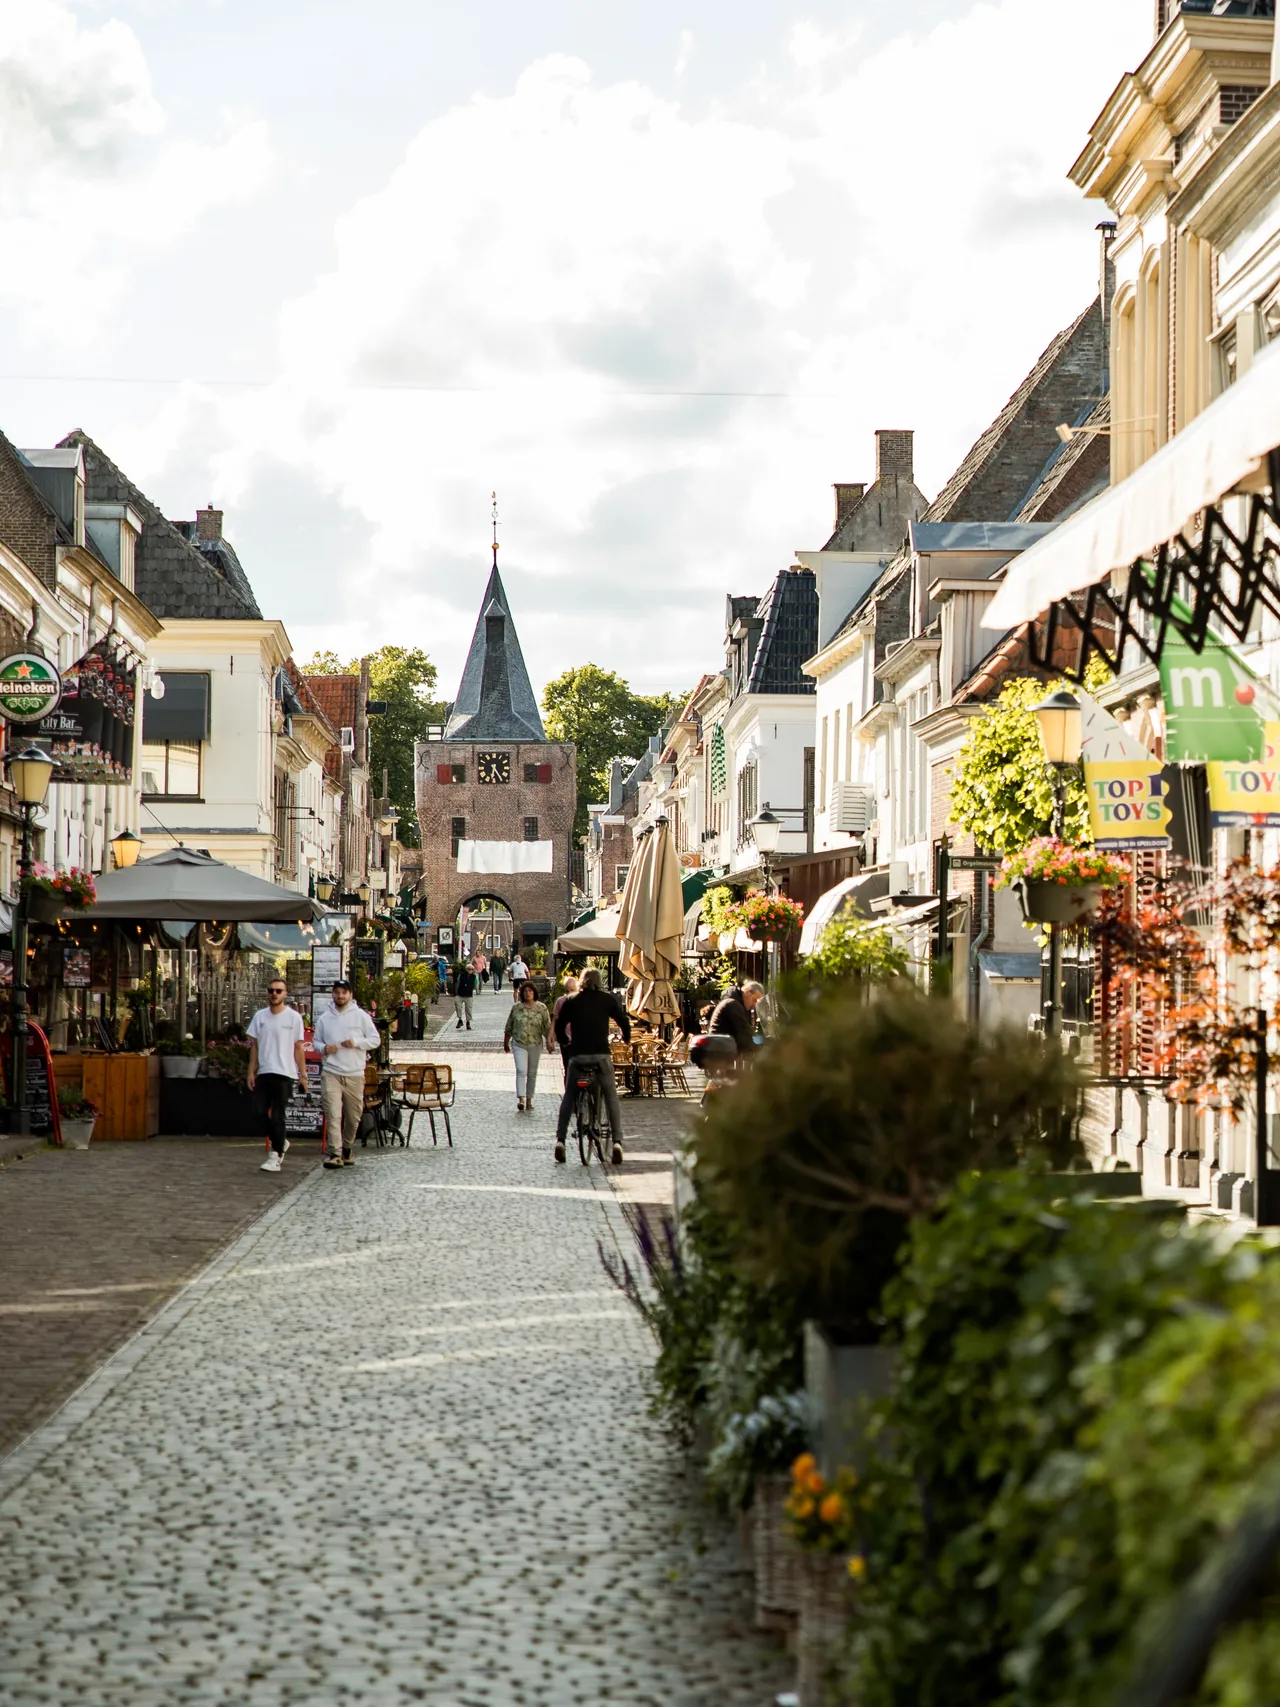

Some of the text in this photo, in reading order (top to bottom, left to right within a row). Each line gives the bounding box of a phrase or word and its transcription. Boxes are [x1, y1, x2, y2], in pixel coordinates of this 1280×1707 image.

[1168, 666, 1225, 708] m
[60, 716, 76, 729] Bar
[1099, 801, 1161, 822] TOYS
